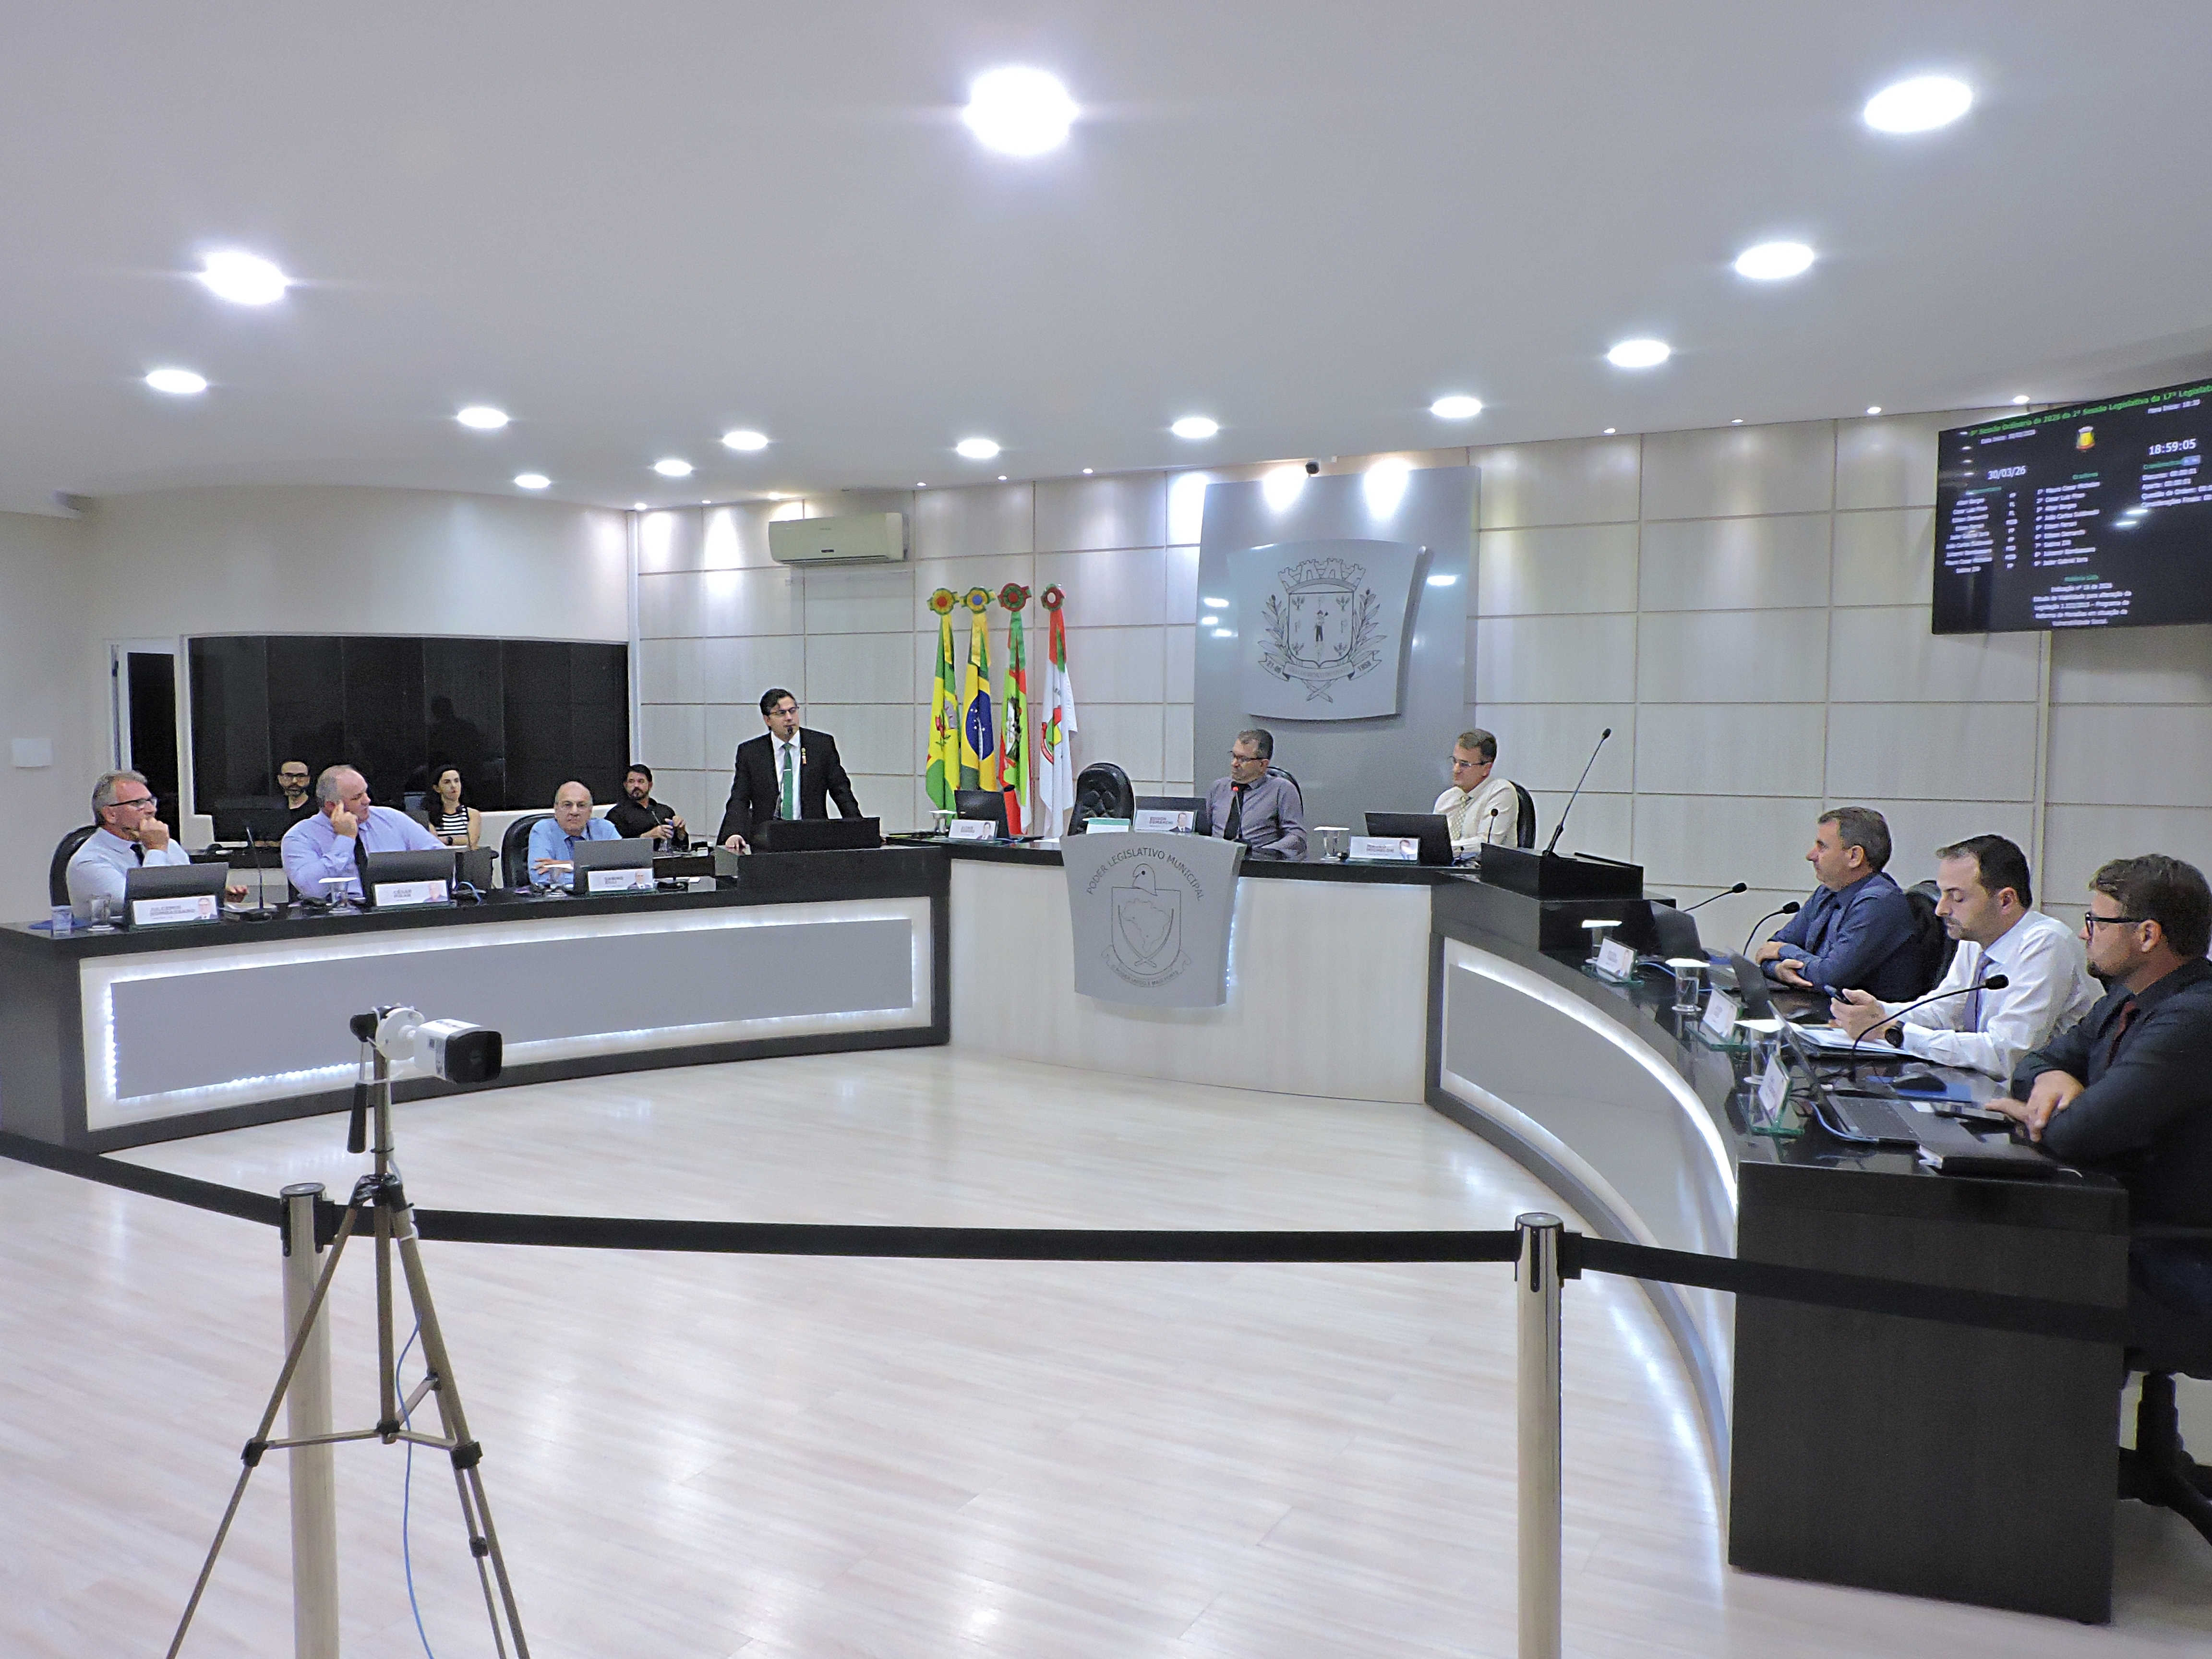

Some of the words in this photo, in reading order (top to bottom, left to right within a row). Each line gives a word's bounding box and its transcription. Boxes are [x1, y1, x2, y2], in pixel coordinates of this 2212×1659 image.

[2149, 438, 2197, 455] 18:59:05
[1987, 465, 2026, 480] 30/03/26
[1086, 865, 1108, 895] PODER
[1108, 847, 1165, 867] LEGISLATIVO
[1167, 854, 1203, 901] MUNICIPAL
